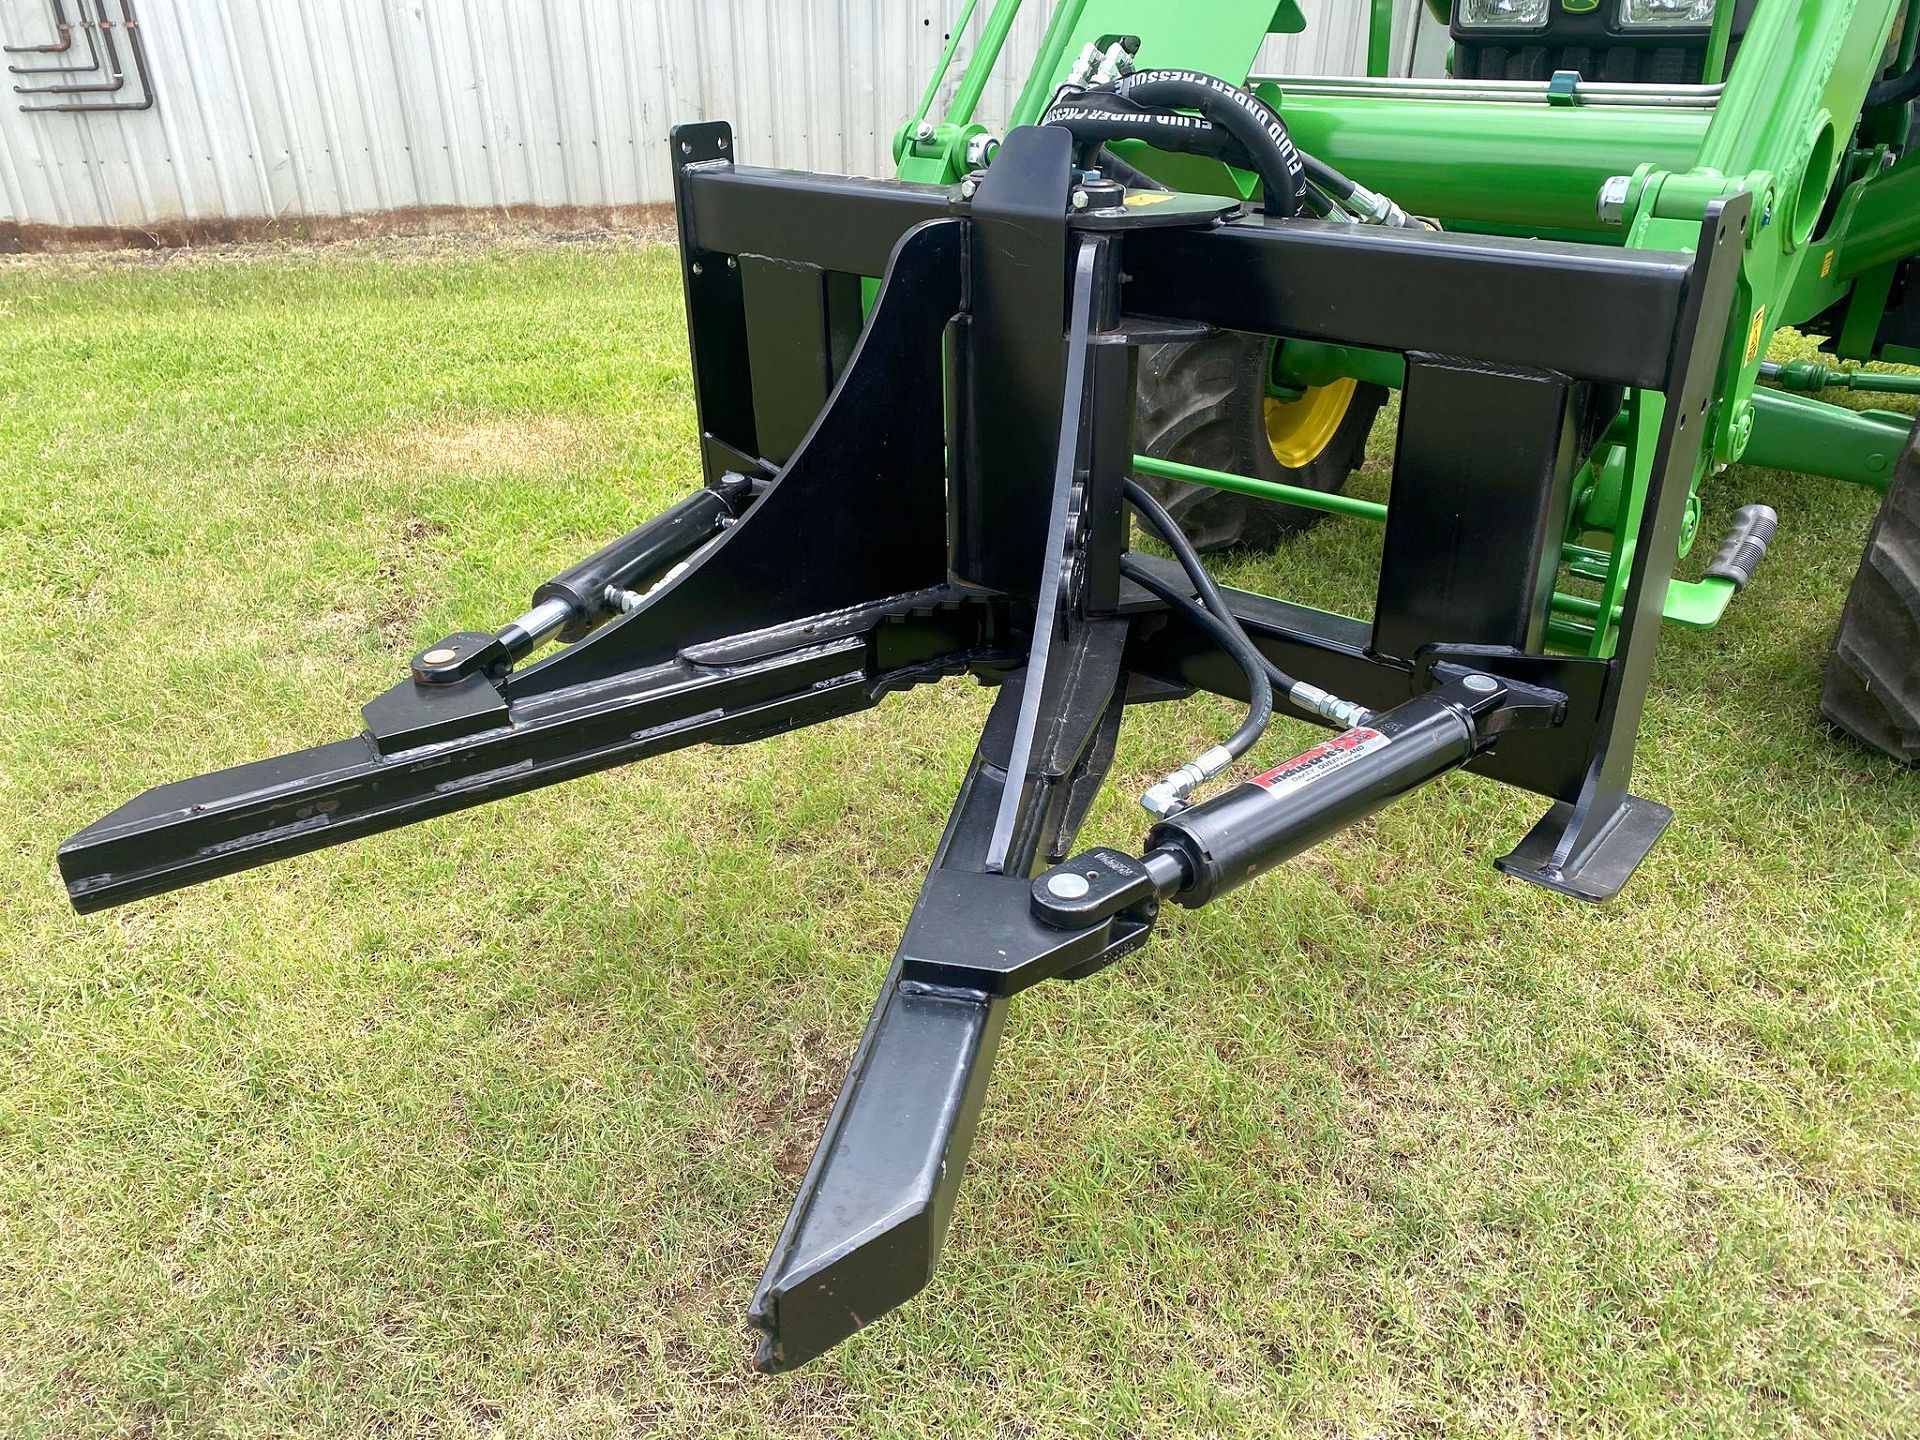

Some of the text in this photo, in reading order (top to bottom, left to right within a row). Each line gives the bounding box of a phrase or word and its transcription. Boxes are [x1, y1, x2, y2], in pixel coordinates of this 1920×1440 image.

[1088, 109, 1151, 122] UNDER
[1211, 79, 1269, 127] UNDER
[1156, 115, 1212, 130] FLUID
[1268, 122, 1303, 176] FLUID
[1318, 745, 1365, 771] QUEENSLAND
